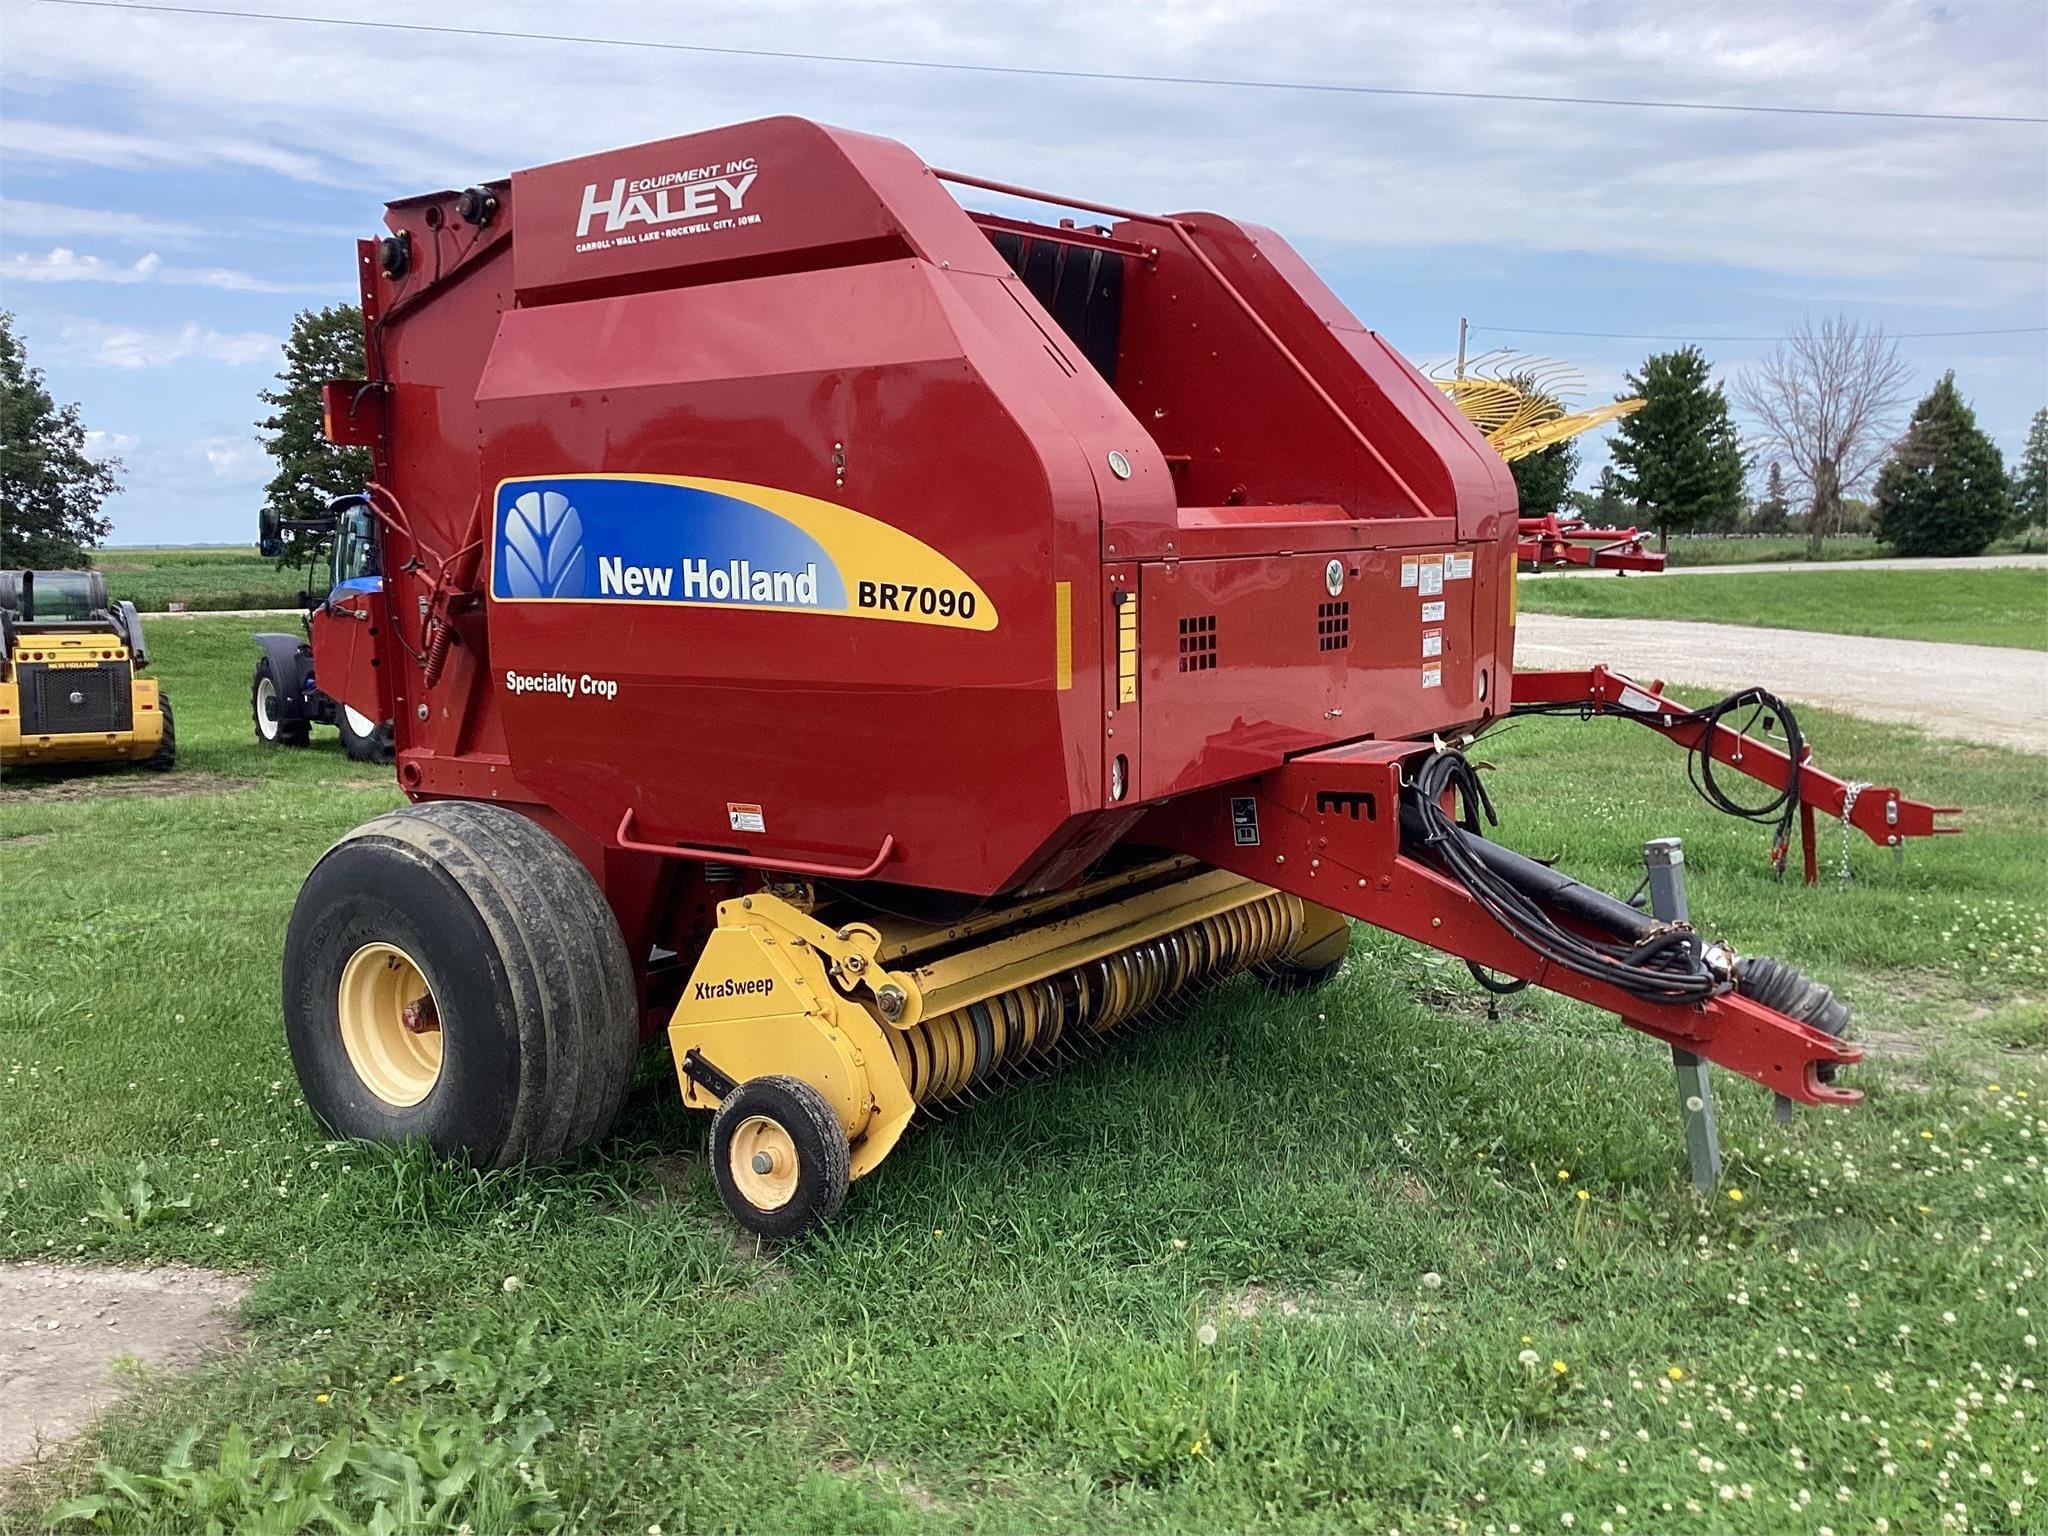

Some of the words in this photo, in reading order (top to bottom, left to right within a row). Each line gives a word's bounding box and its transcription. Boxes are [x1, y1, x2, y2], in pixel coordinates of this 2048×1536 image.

[629, 165, 721, 193] EQUIPMENT
[726, 157, 758, 174] INC.
[576, 173, 758, 237] HALEY
[576, 239, 611, 253] CARROLL
[615, 235, 637, 247] WALL
[639, 231, 660, 243] LAKE
[665, 222, 711, 238] ROCKWELL
[713, 218, 736, 230] CITY,
[738, 214, 762, 227] IOWA
[599, 556, 673, 597] New
[682, 558, 818, 605] Holland
[858, 581, 976, 619] BR7090
[506, 670, 577, 698] Specialty
[580, 674, 618, 700] Crop
[694, 977, 774, 1001] XtraSweep
